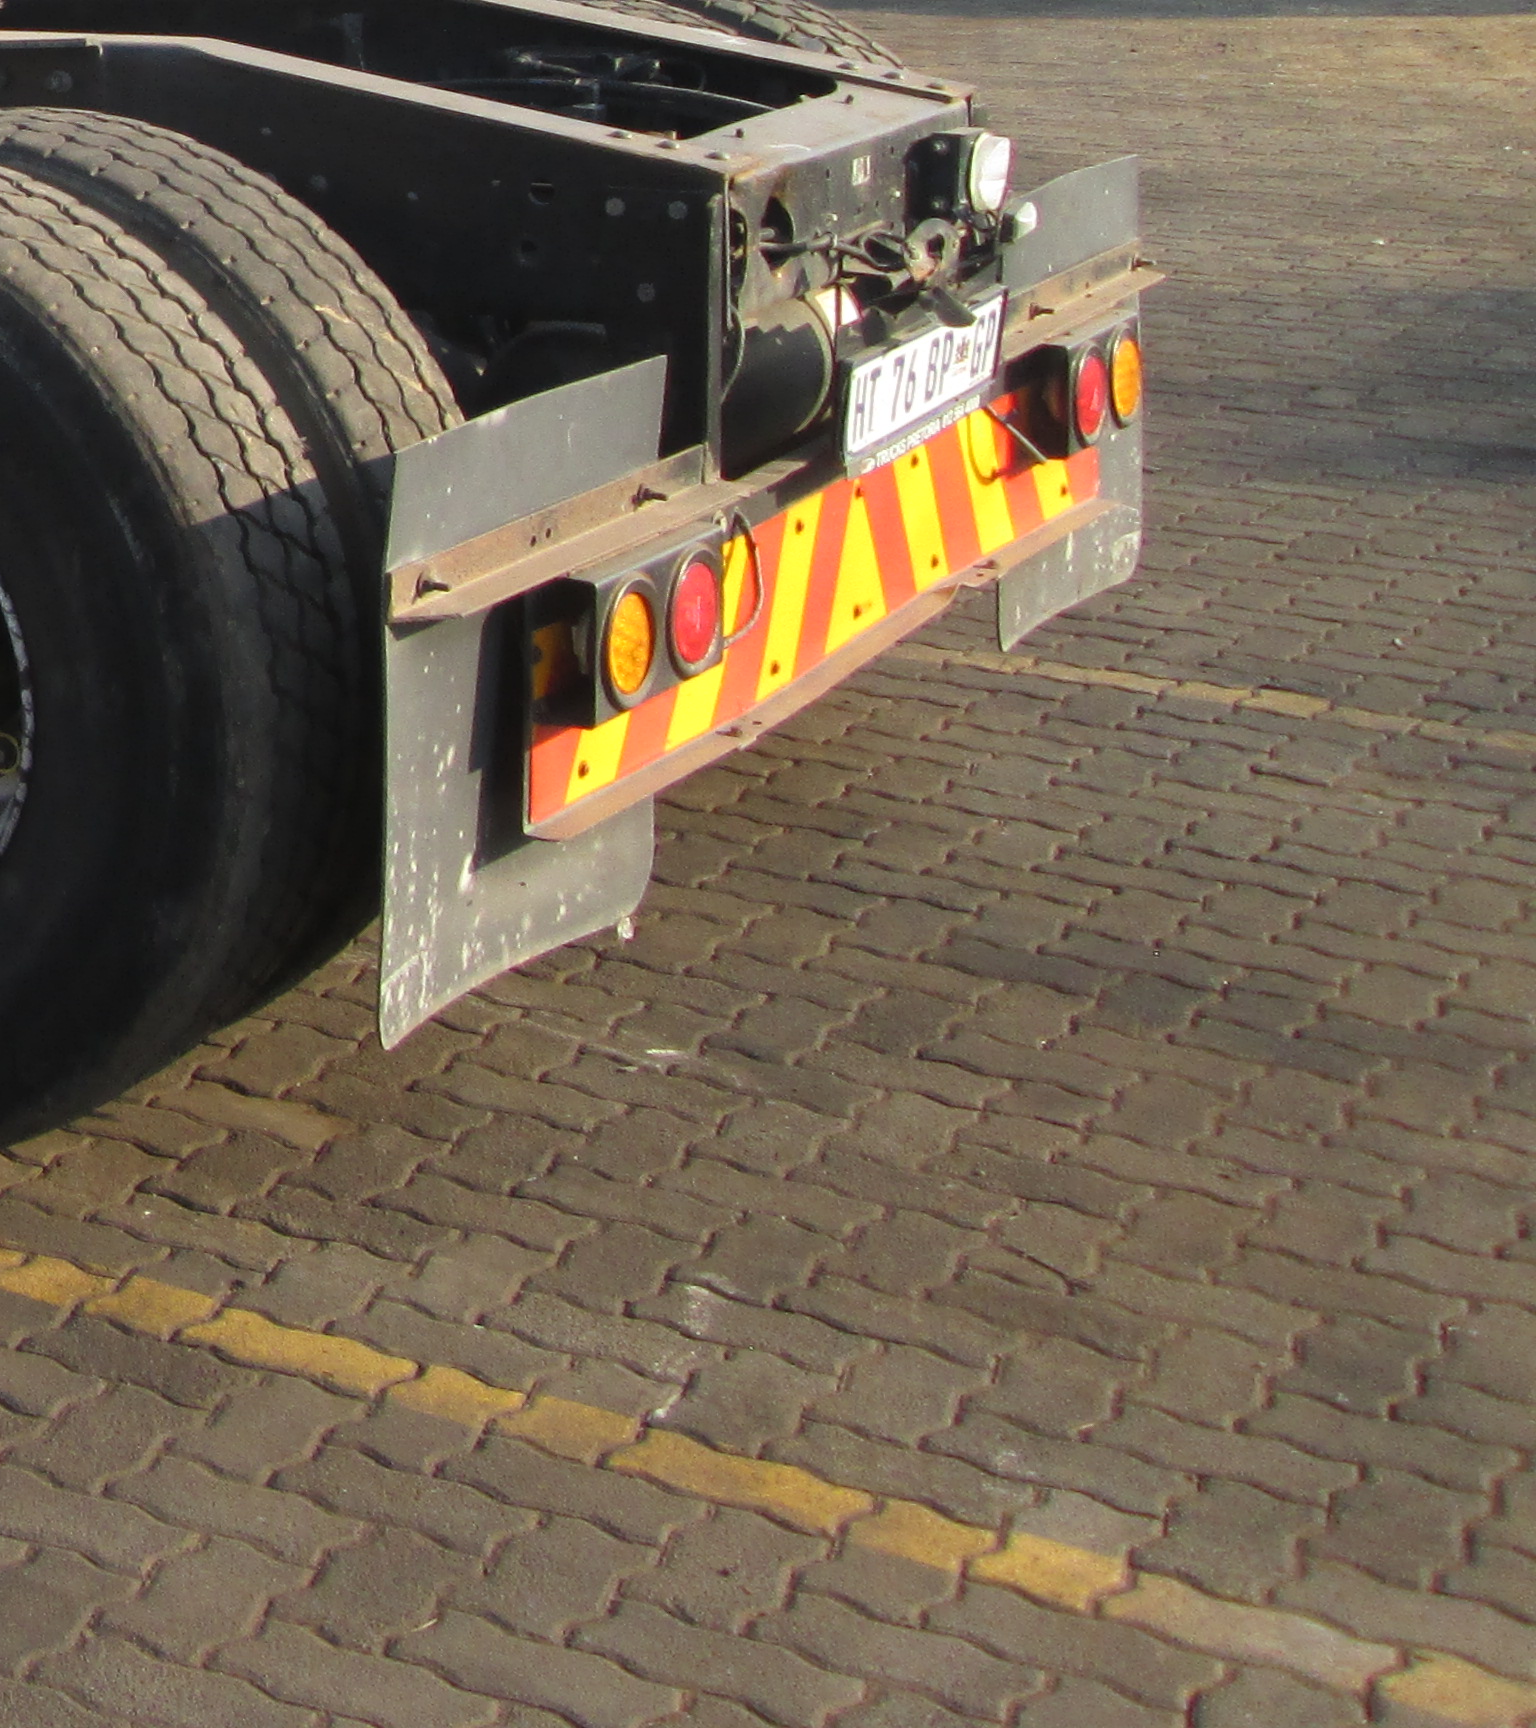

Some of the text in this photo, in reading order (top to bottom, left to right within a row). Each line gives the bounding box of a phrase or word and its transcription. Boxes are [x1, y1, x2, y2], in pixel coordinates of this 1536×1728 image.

[853, 308, 997, 444] HT 76 BP GP
[876, 438, 907, 467] TRUCKS
